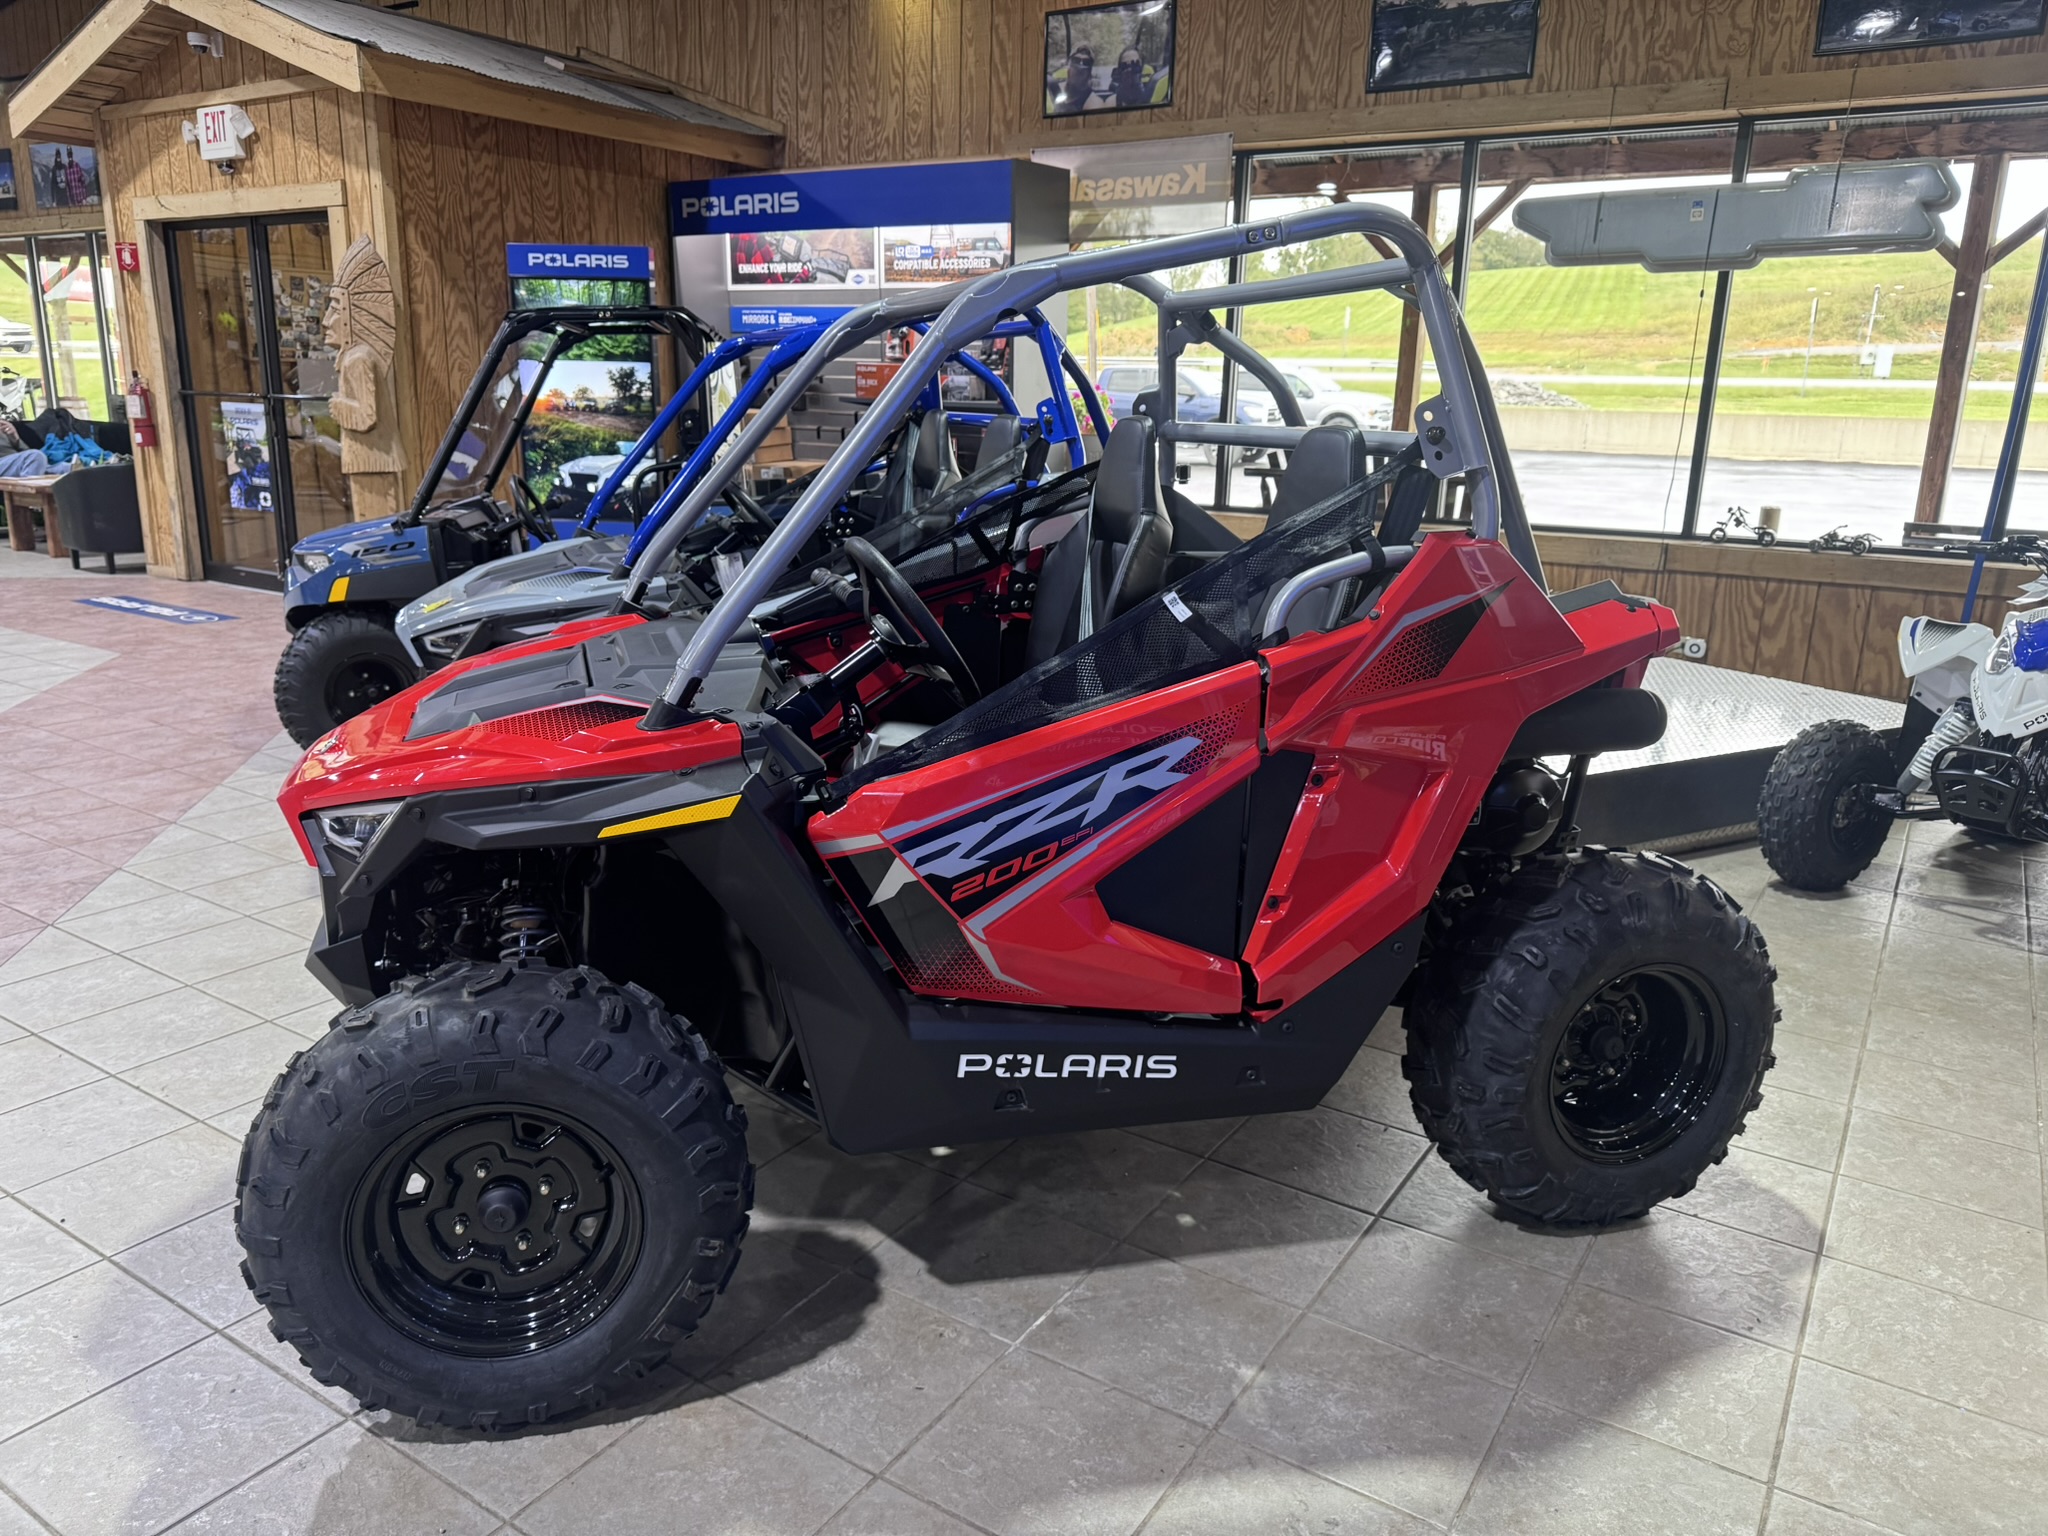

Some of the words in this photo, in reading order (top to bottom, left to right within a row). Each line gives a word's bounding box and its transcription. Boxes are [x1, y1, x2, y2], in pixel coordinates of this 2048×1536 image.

[204, 110, 226, 144] EXIT
[681, 191, 800, 218] POLARIS
[527, 252, 630, 269] POLARIS
[738, 263, 769, 274] ENHANCE
[769, 262, 787, 273] YOUR
[787, 262, 803, 273] RIDE
[893, 258, 939, 270] COMPATIBLE
[940, 258, 991, 269] ACCESSORIES
[351, 541, 416, 558] 150
[2023, 712, 2048, 730] PO
[867, 735, 1203, 907] RZR
[950, 841, 1060, 902] 200
[1060, 826, 1095, 847] EFI
[957, 1053, 1178, 1079] POLARIS
[361, 1058, 516, 1130] CST
